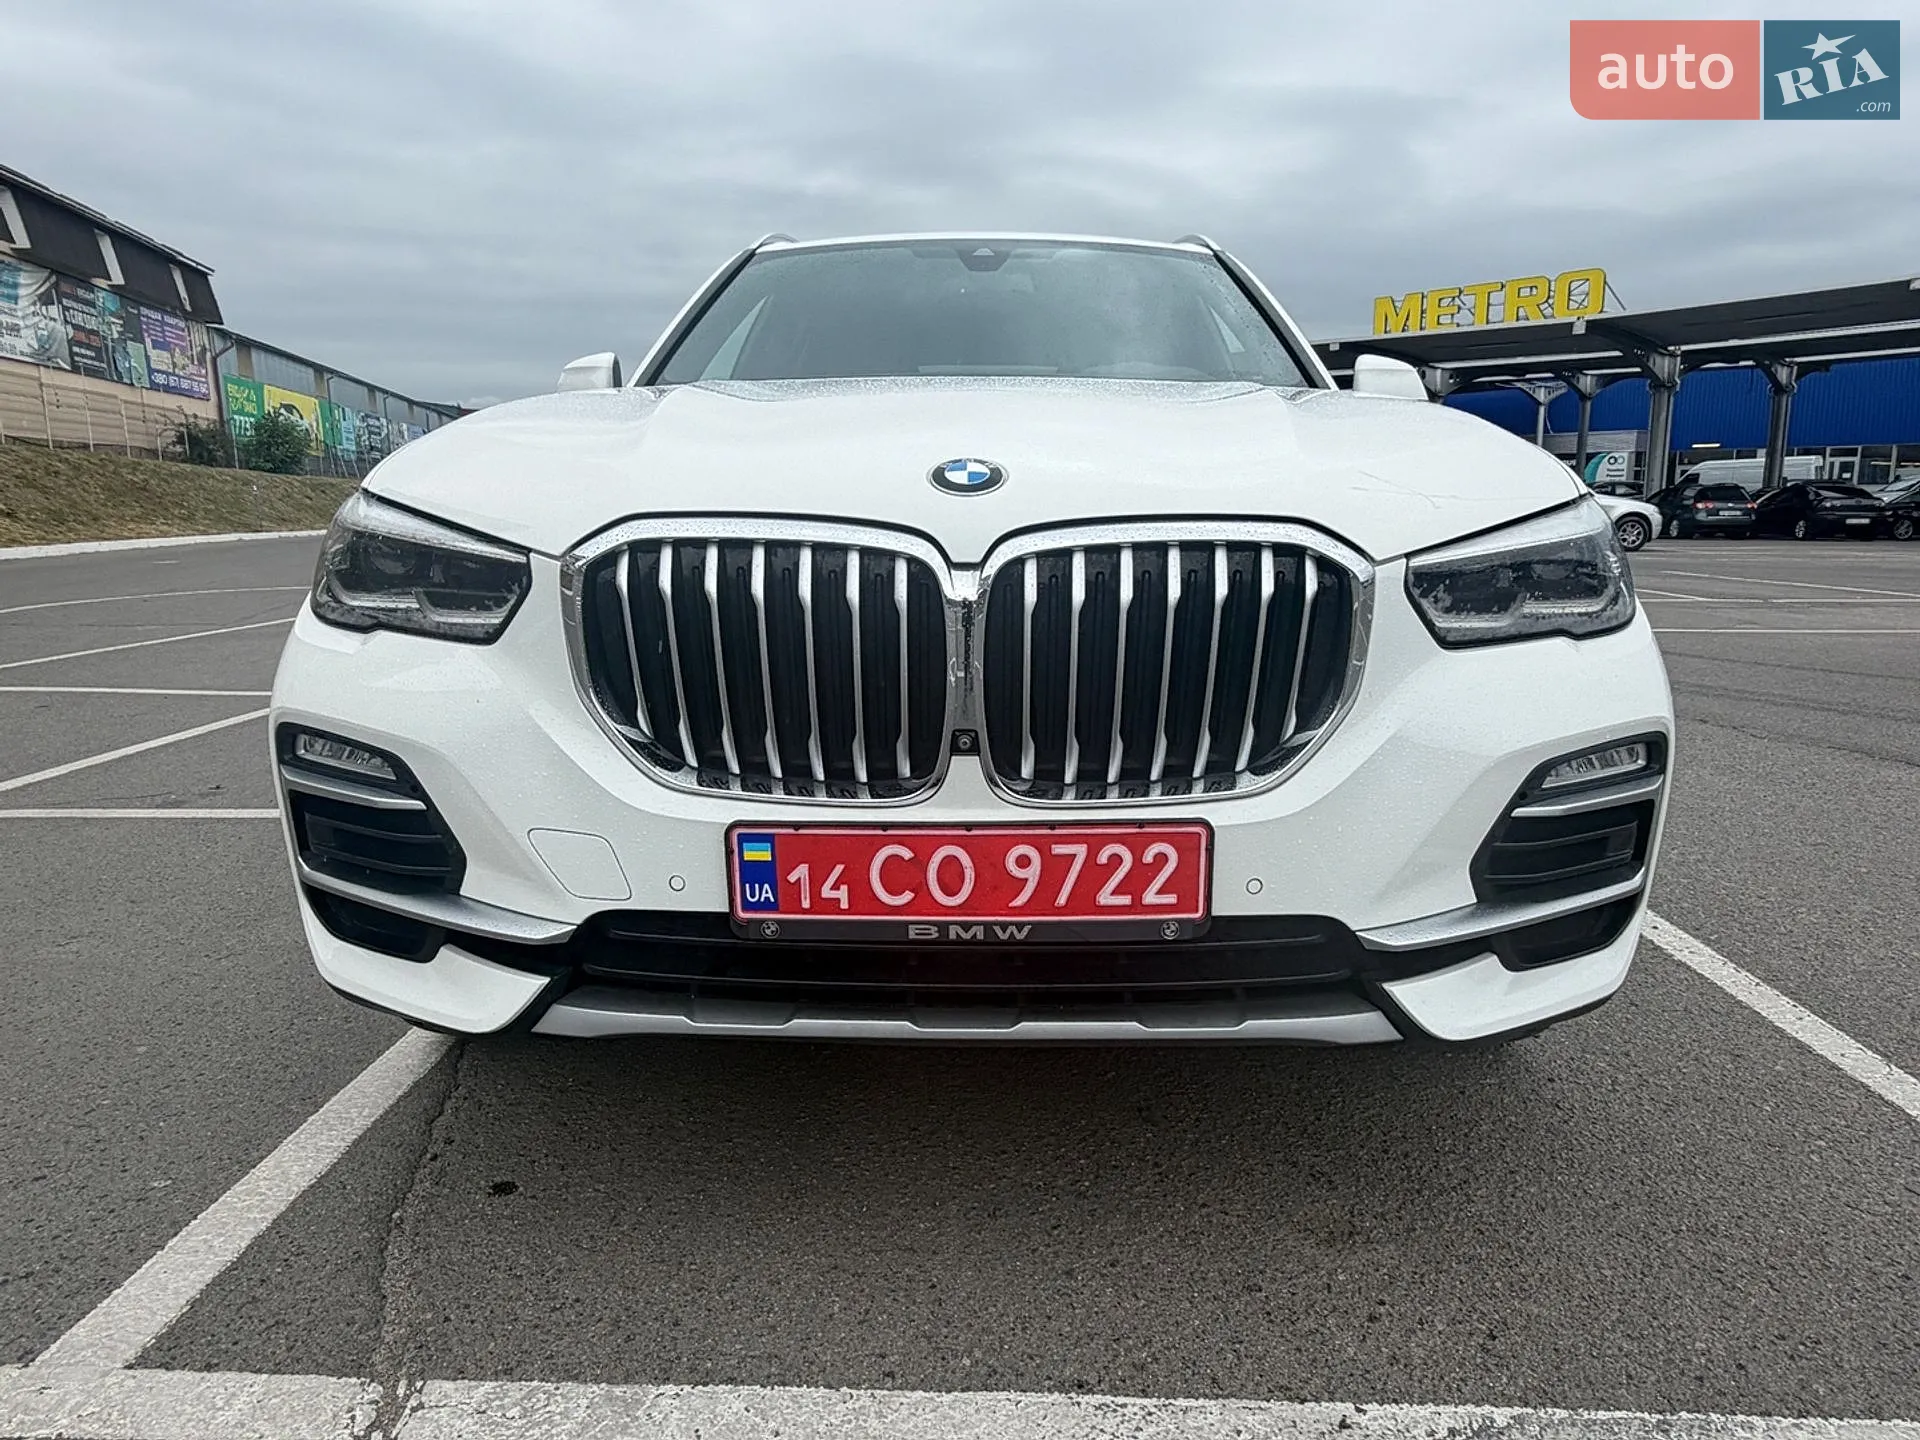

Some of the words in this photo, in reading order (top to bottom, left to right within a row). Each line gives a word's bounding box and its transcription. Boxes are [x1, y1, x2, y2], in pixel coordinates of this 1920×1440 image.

[1373, 267, 1607, 336] METRO
[744, 882, 775, 903] UA
[786, 863, 849, 910] 14
[868, 843, 976, 907] CO
[1003, 842, 1180, 907] 9722
[908, 923, 1032, 940] BMW
